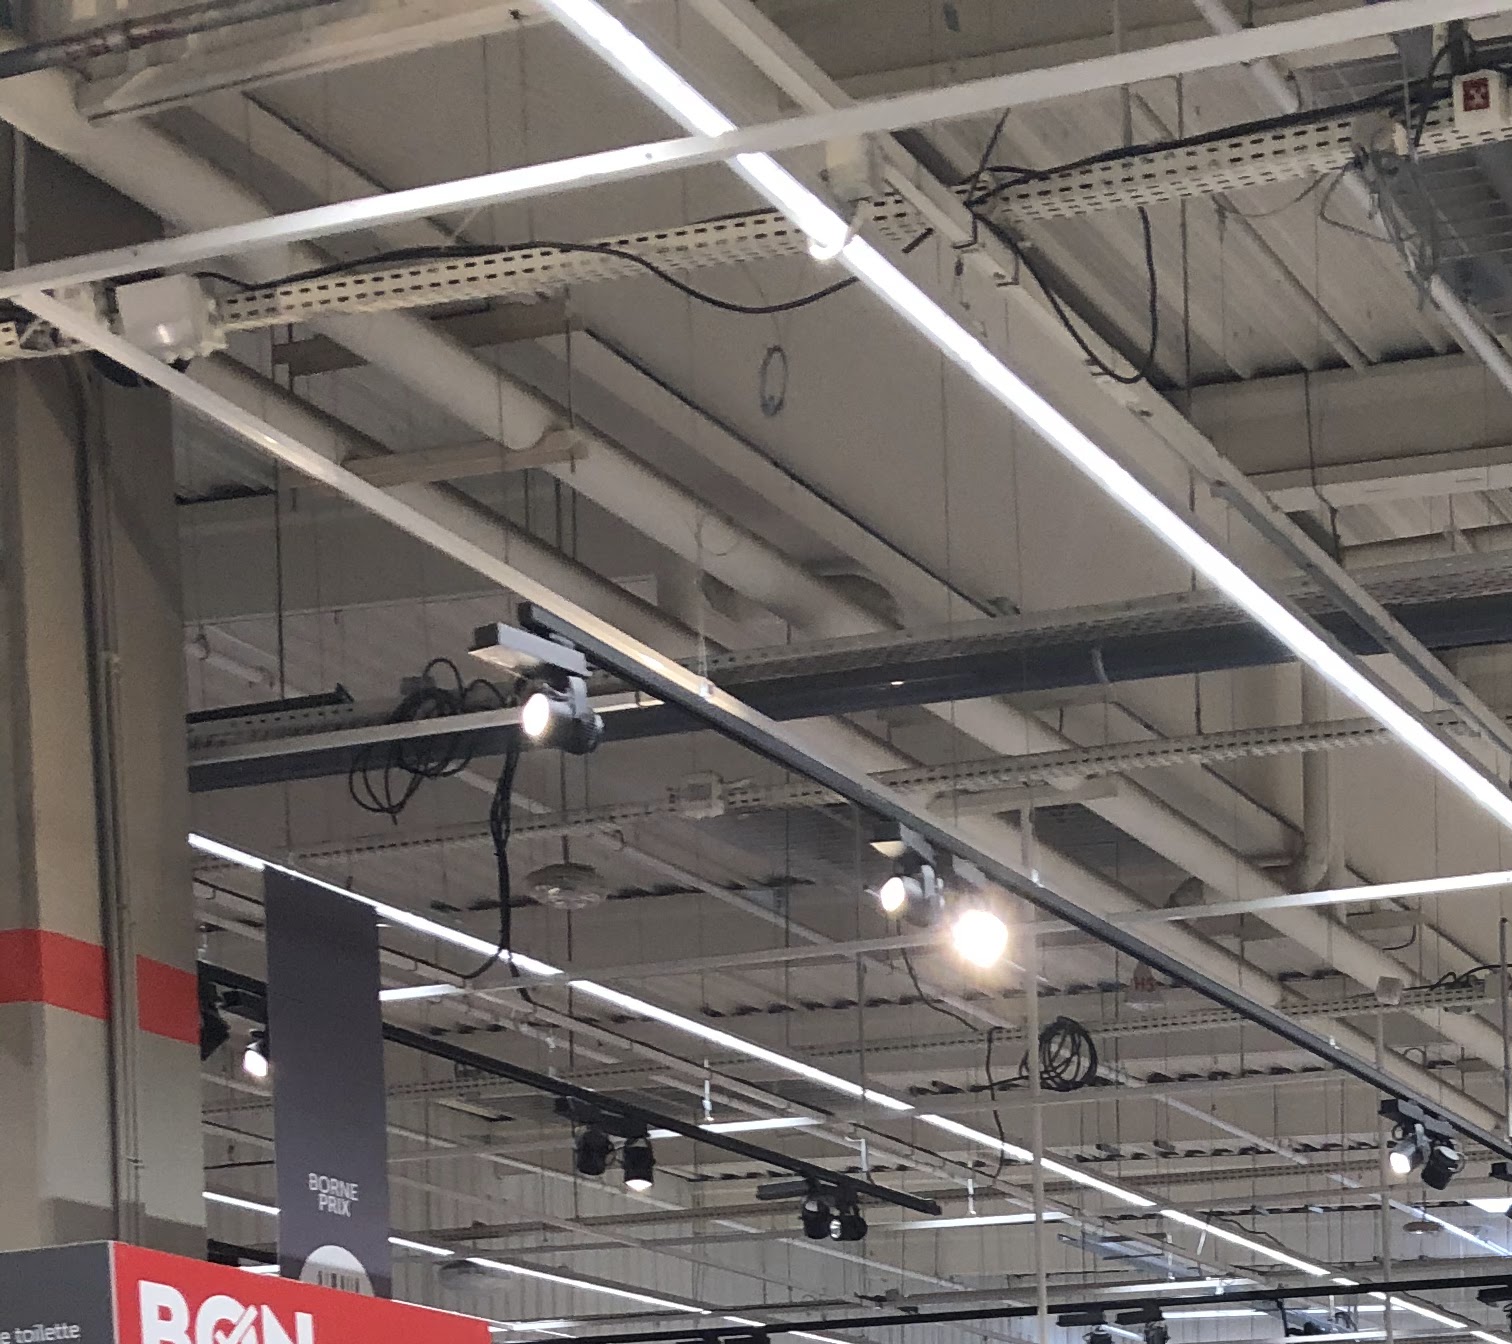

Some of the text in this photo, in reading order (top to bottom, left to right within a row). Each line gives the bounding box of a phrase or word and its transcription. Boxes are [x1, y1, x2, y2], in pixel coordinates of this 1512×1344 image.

[308, 1172, 358, 1201] BORNE
[318, 1193, 351, 1217] PRIX
[14, 1323, 81, 1344] toilette
